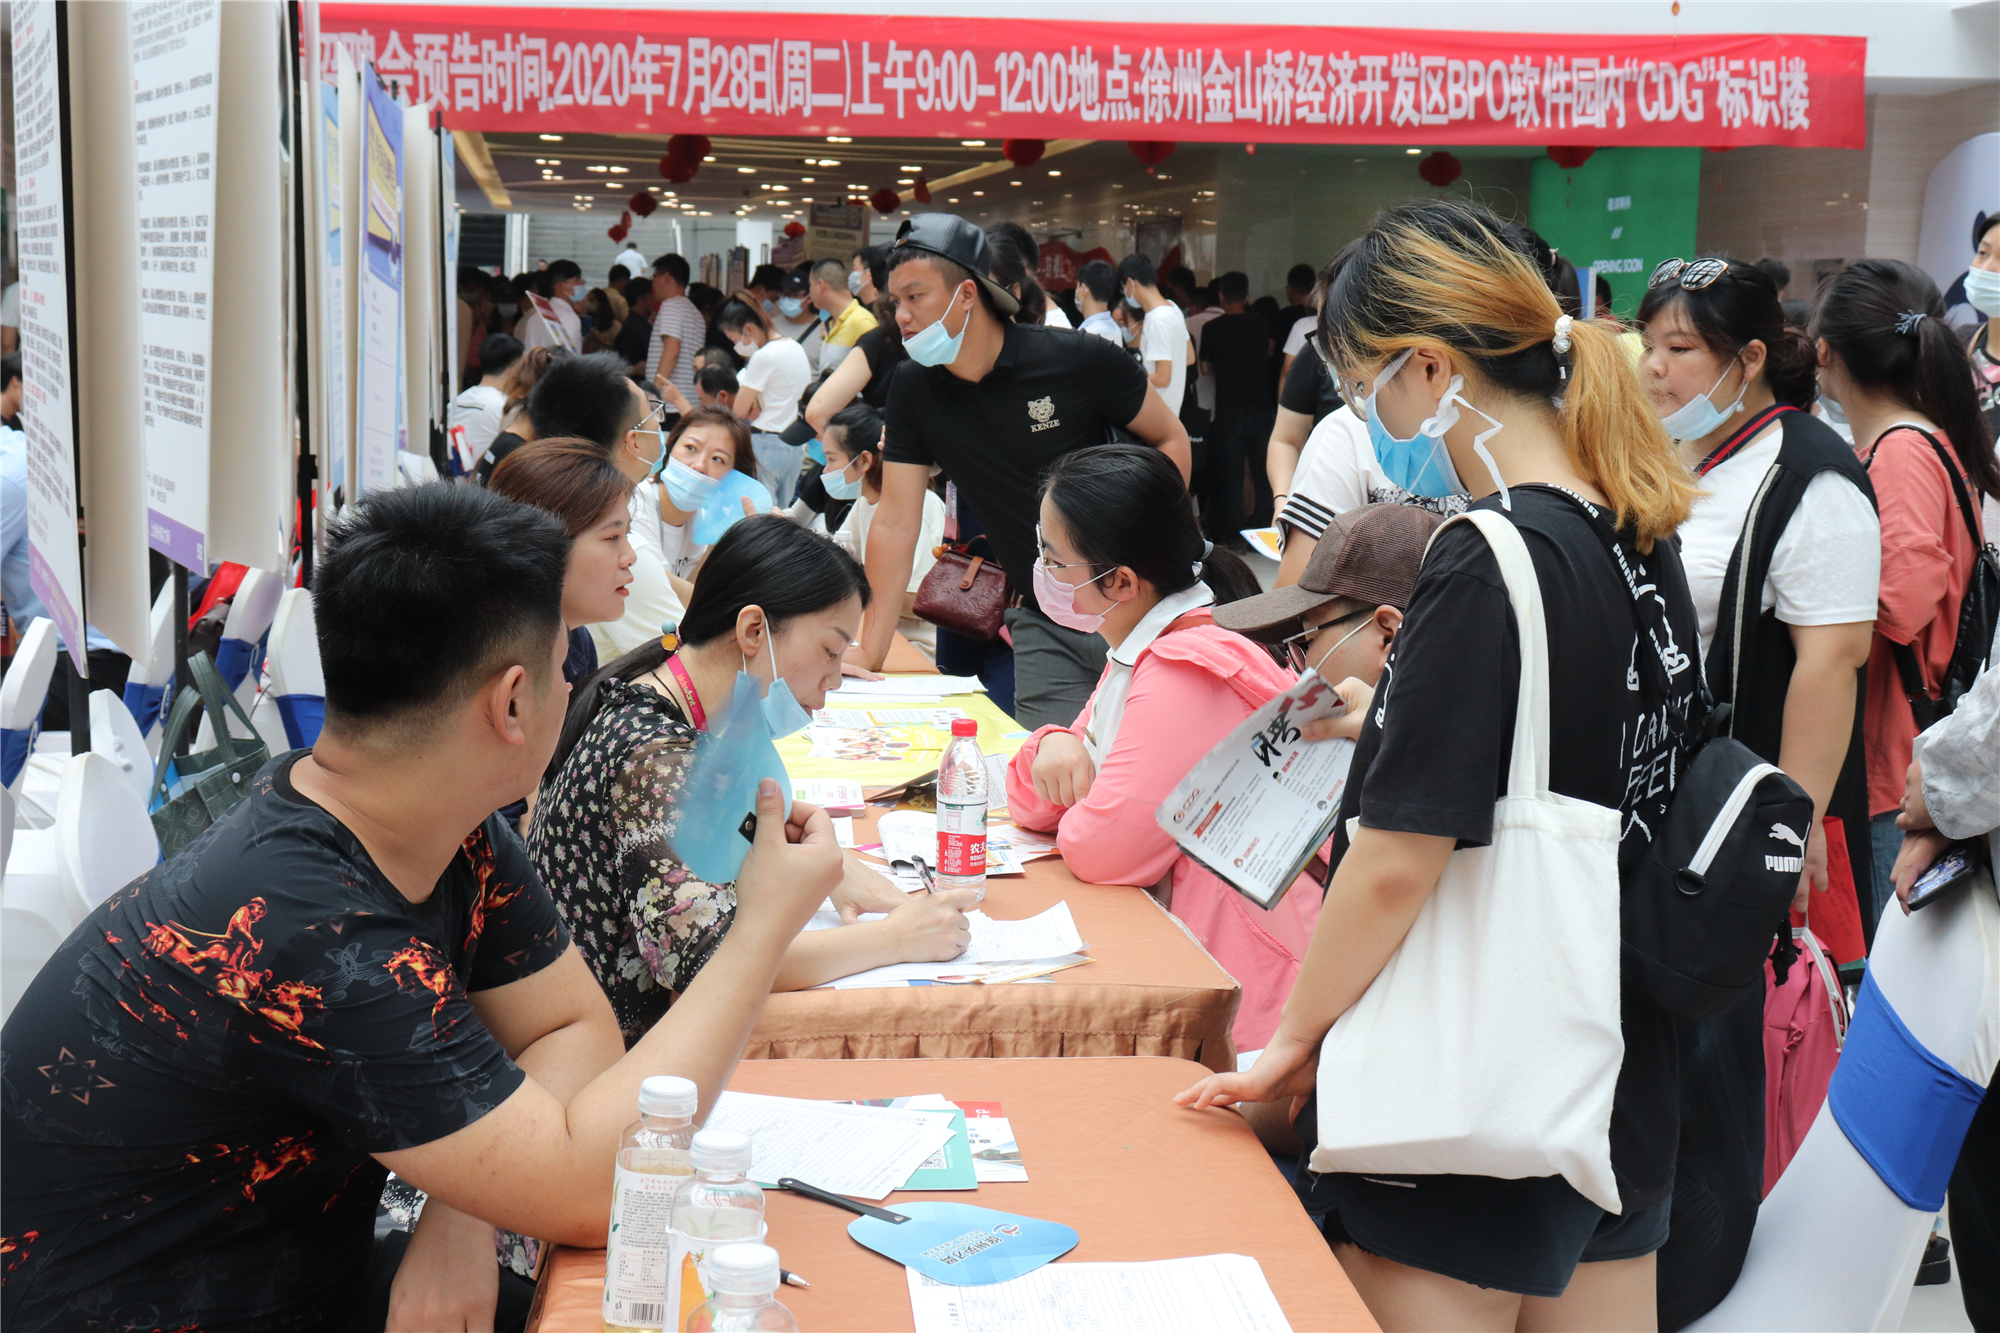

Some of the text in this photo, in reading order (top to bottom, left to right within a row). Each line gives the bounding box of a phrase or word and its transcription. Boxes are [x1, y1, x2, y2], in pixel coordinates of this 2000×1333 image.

[1623, 258, 1643, 272] SOON
[1612, 542, 1641, 601] PUMA
[1182, 787, 1200, 811] CDG
